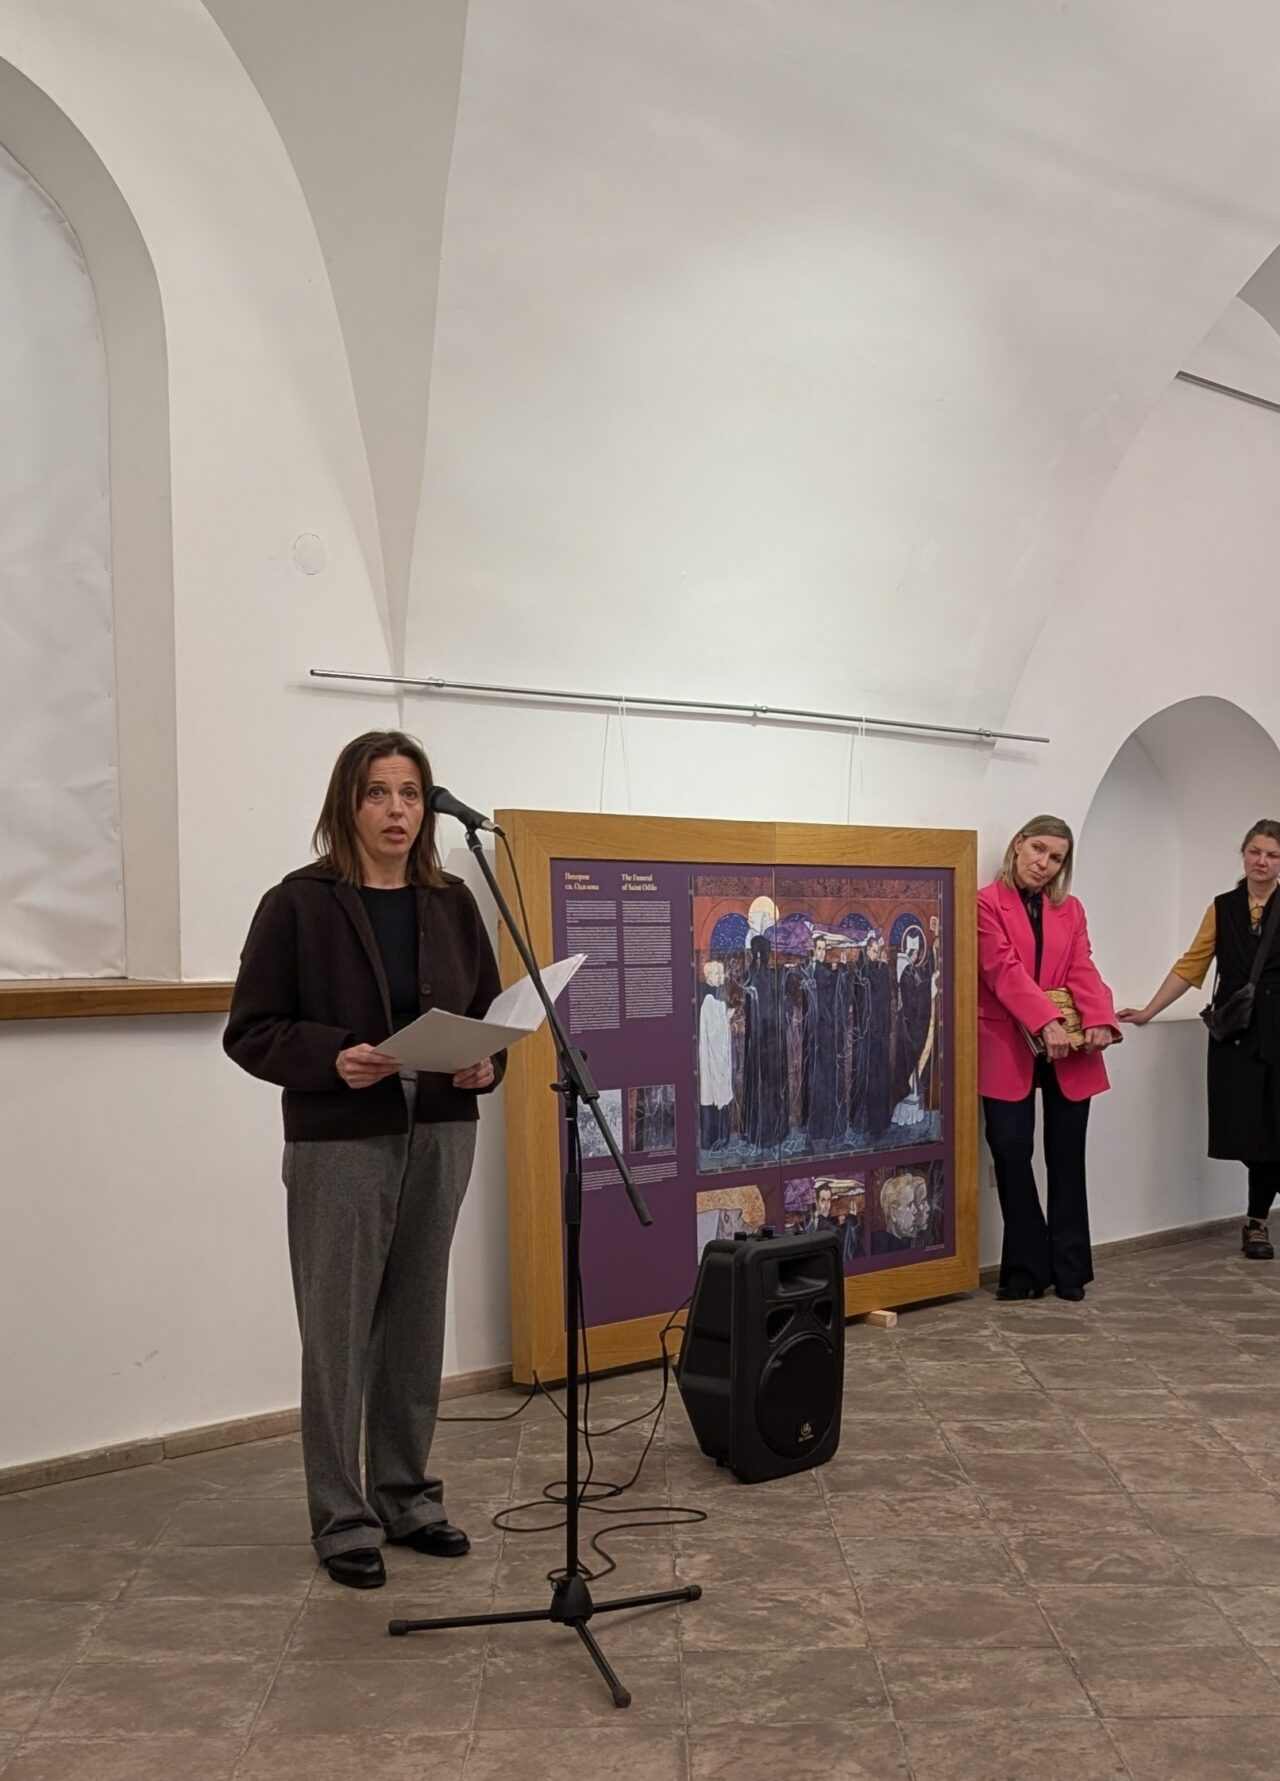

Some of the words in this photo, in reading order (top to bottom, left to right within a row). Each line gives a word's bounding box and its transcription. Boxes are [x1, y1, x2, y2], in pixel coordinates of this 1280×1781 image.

[621, 883, 629, 891] of
[629, 883, 641, 891] Saint
[642, 883, 657, 891] Odilo
